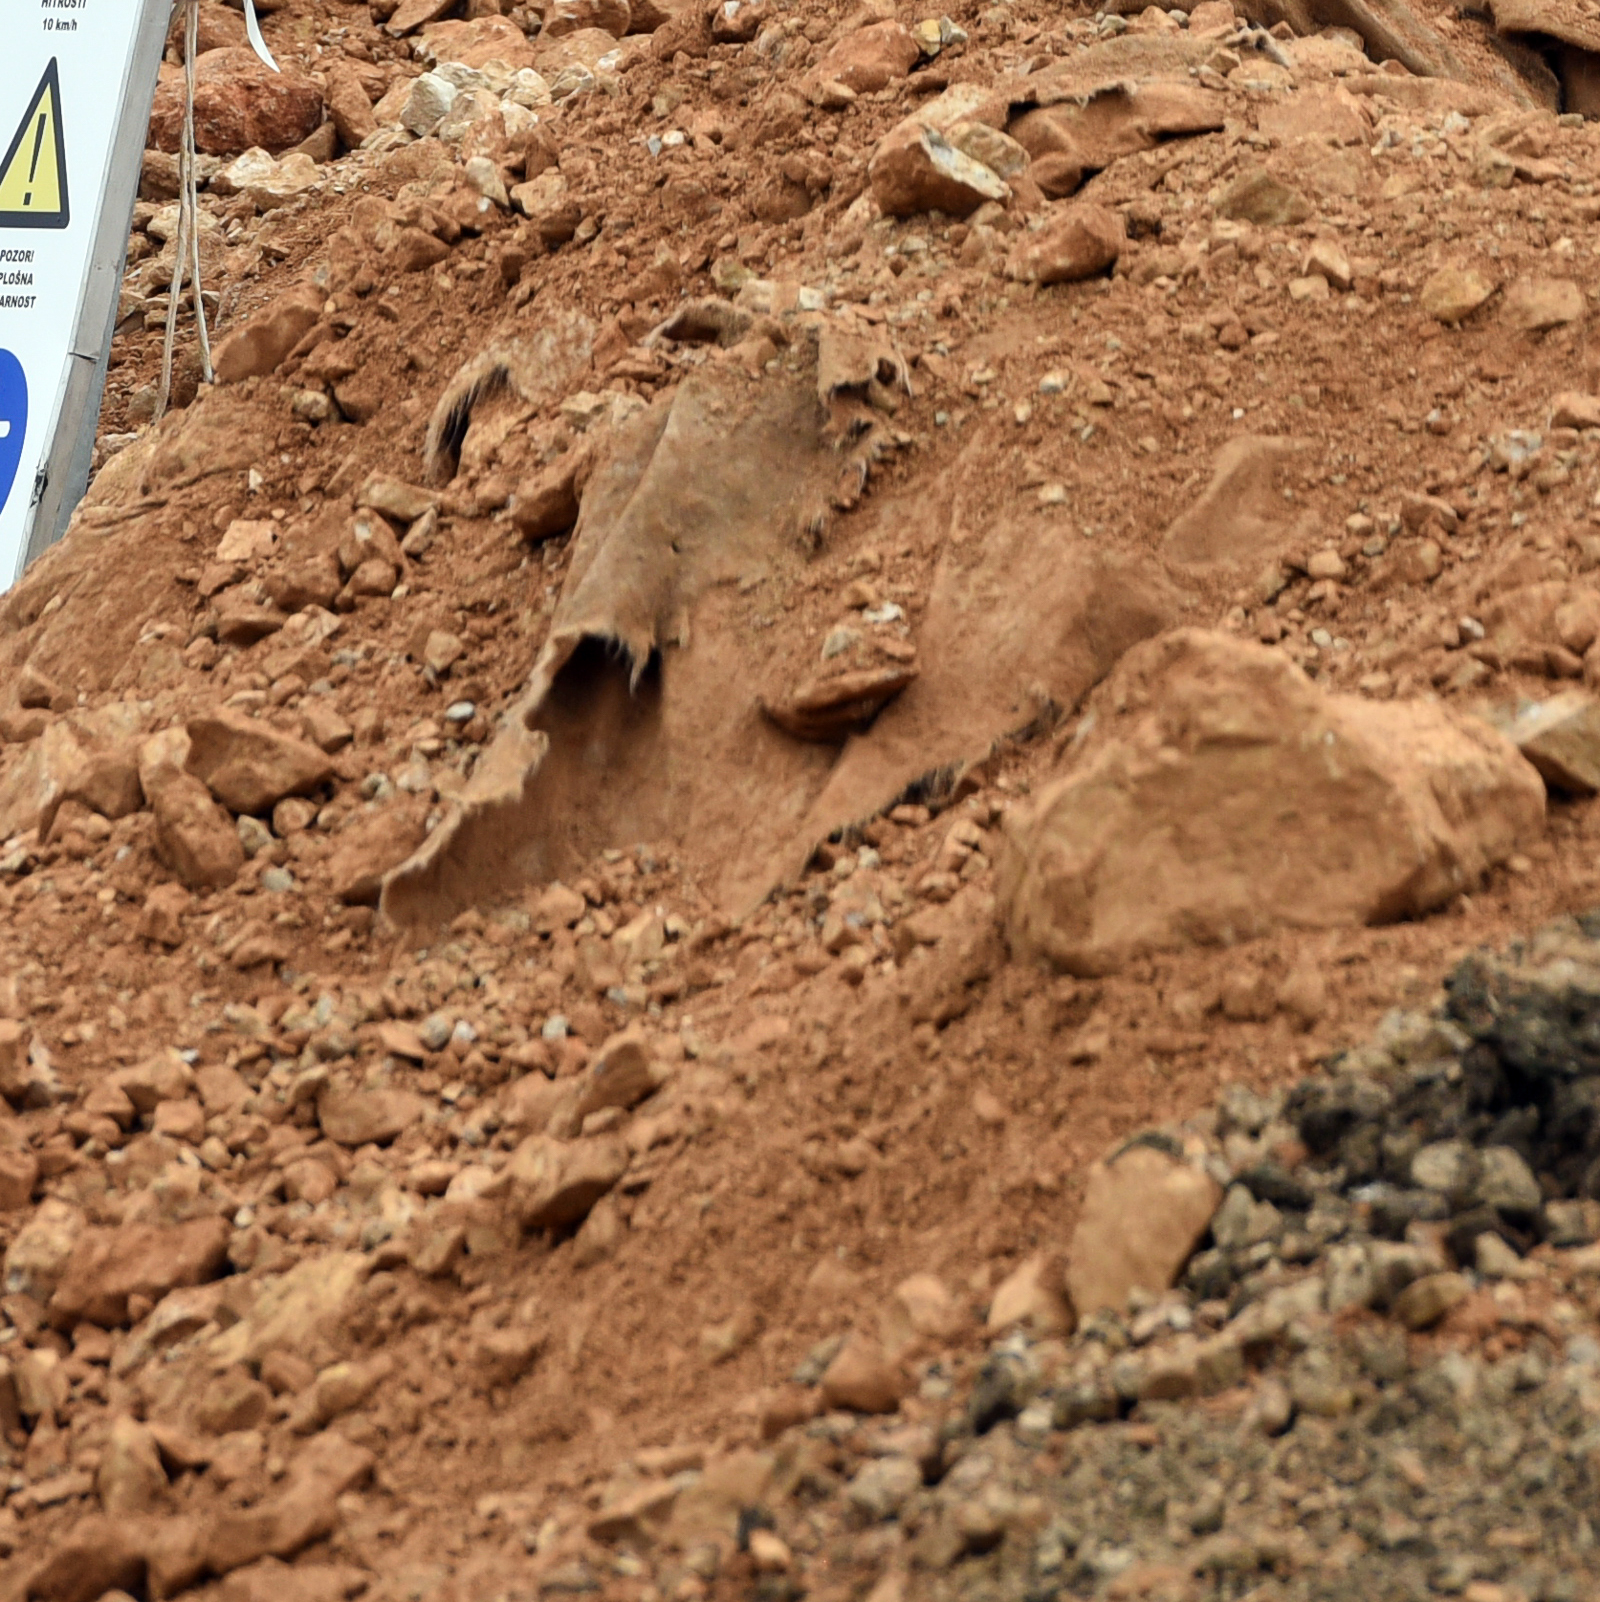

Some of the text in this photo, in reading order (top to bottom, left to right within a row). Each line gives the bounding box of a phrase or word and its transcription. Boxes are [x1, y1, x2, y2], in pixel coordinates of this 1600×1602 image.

[43, 18, 77, 30] 10 km/h
[0, 250, 34, 262] POZOR!
